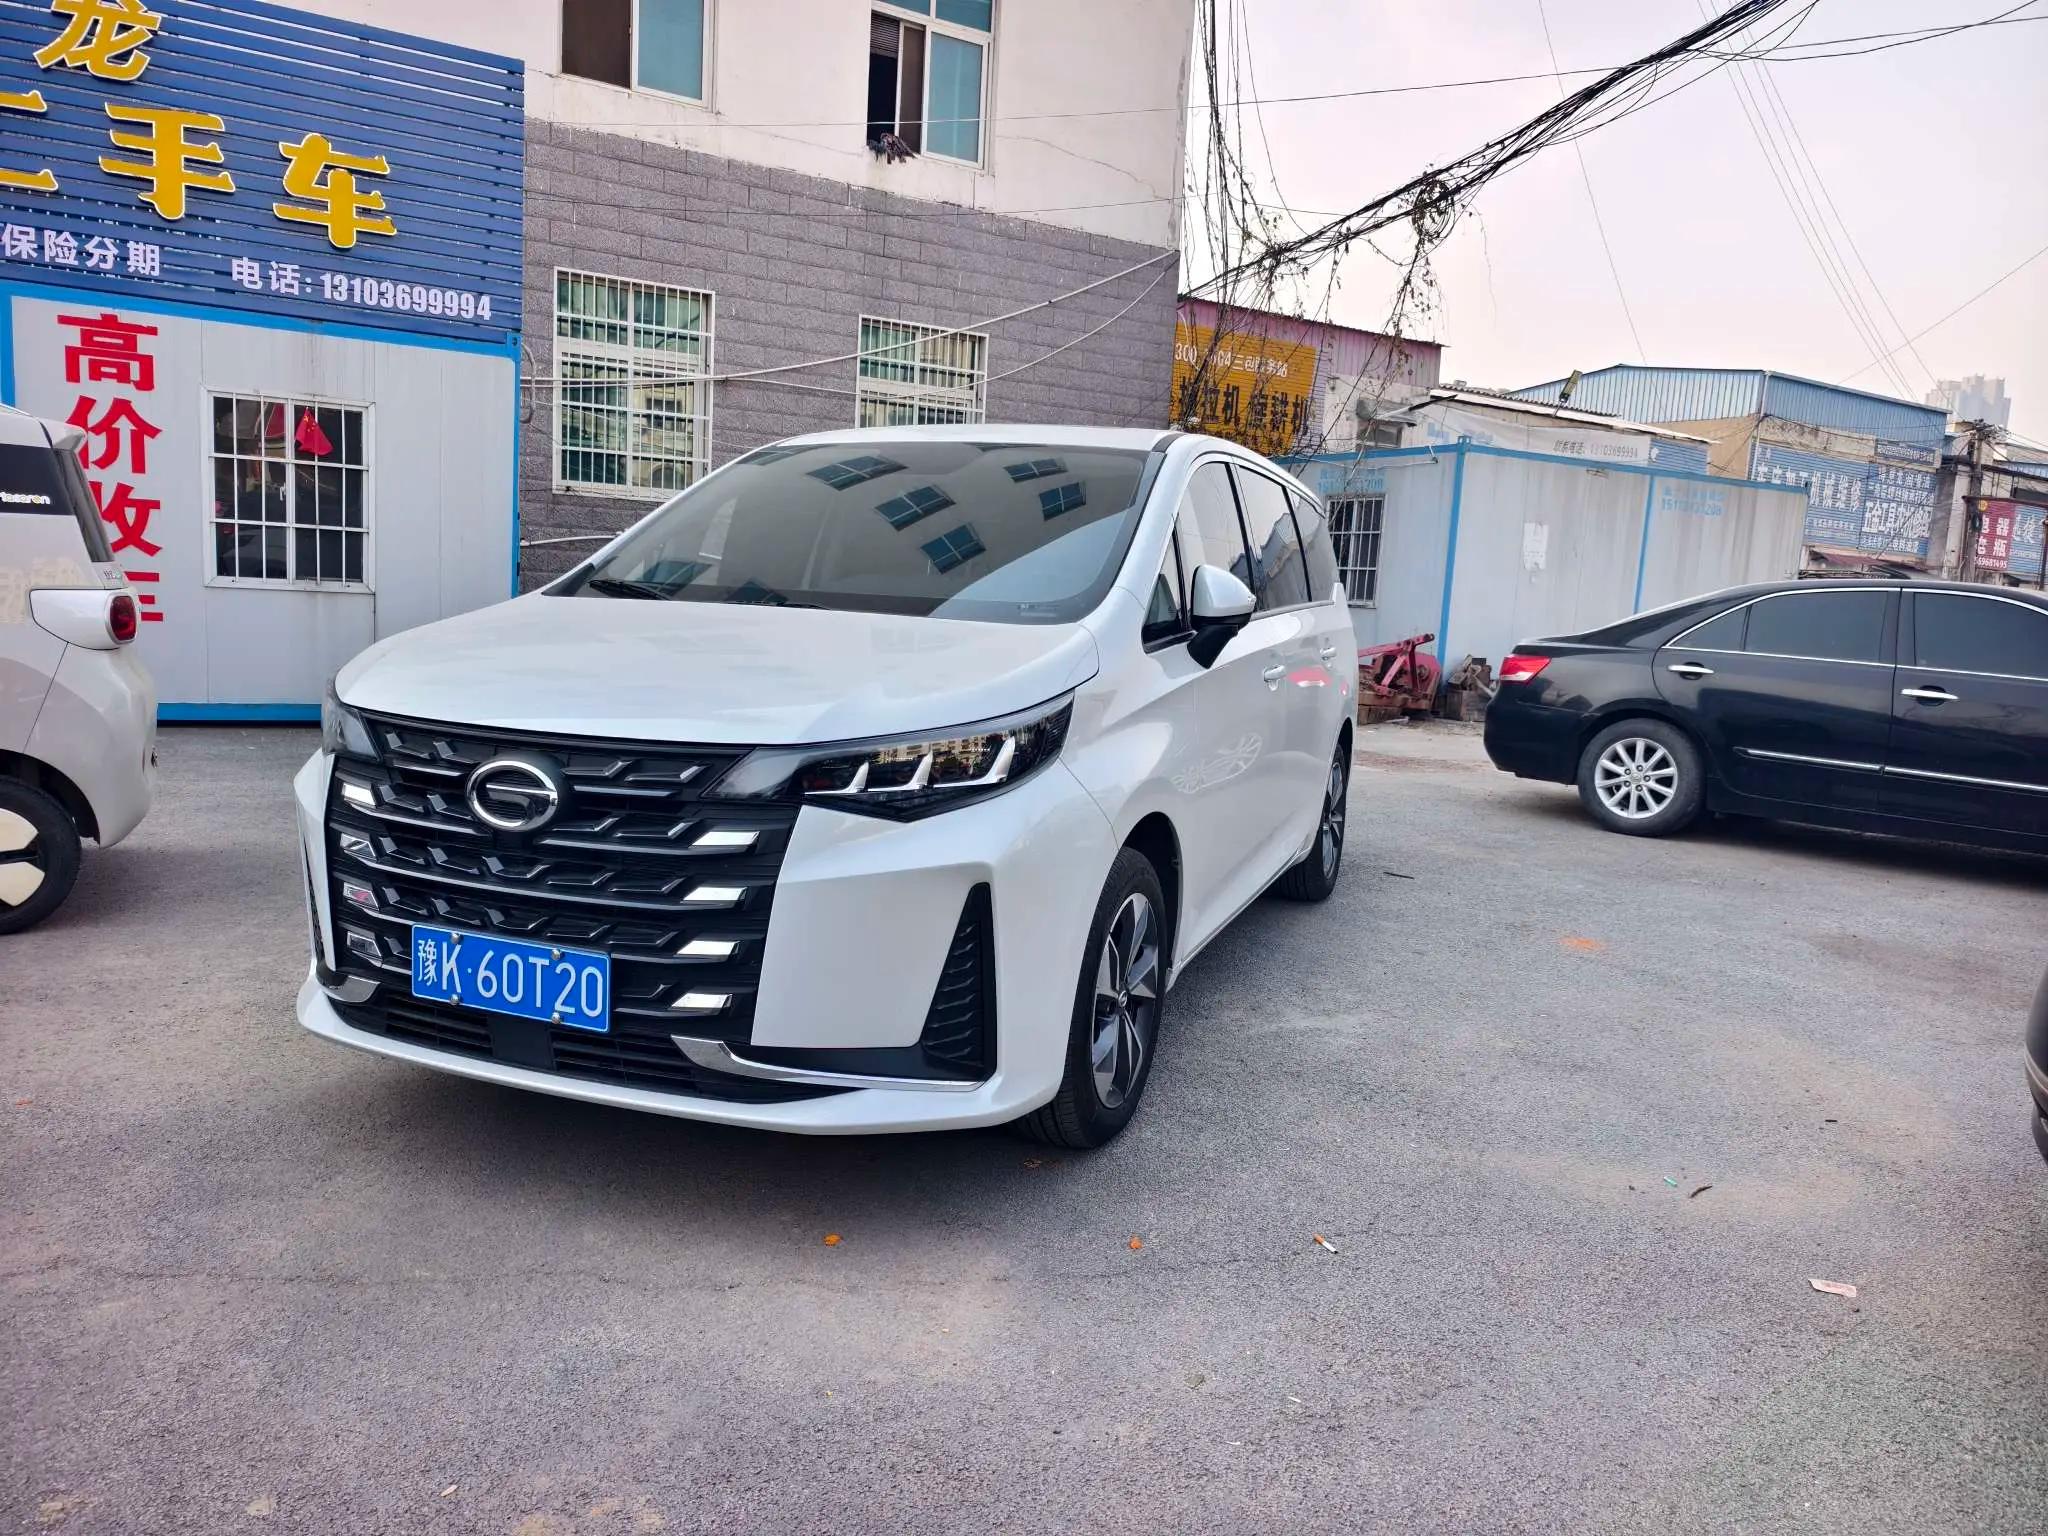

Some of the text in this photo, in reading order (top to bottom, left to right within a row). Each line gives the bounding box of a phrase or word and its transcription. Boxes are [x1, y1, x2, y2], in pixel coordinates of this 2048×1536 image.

[33, 0, 162, 81] 龙
[2, 222, 162, 278] 保险分期
